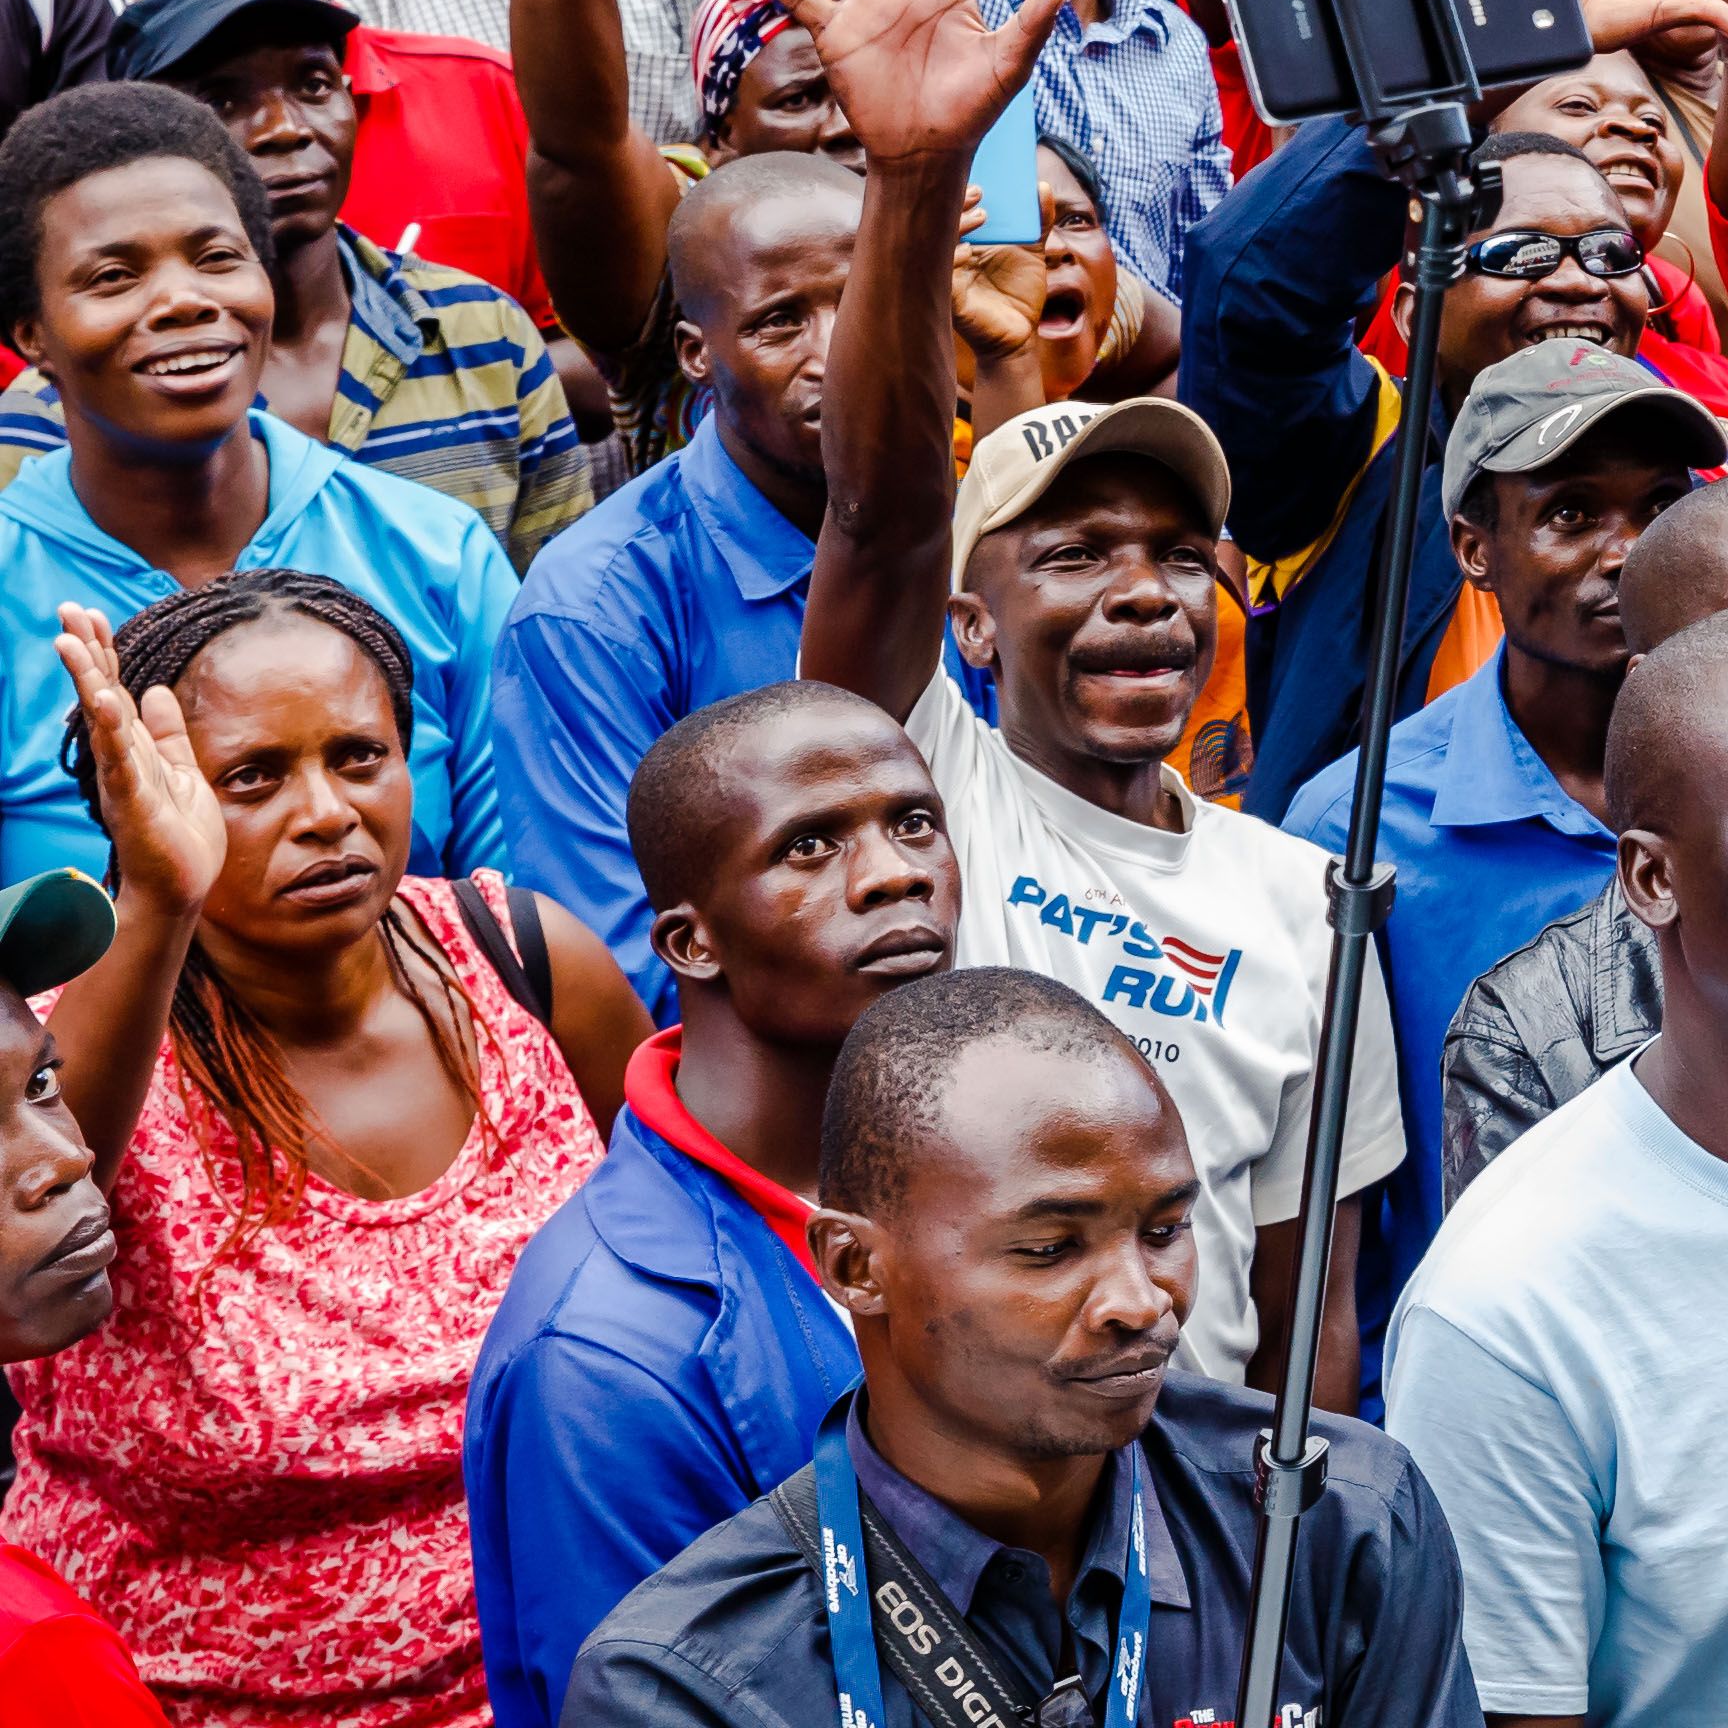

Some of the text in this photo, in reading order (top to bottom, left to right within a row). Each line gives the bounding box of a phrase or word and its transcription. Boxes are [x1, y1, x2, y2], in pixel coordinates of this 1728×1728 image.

[1006, 875, 1164, 960] PAT'S
[1101, 949, 1243, 1030] RUN
[822, 1527, 841, 1614] zimbabwe
[875, 1580, 941, 1656] EOS
[1189, 1708, 1215, 1725] THE
